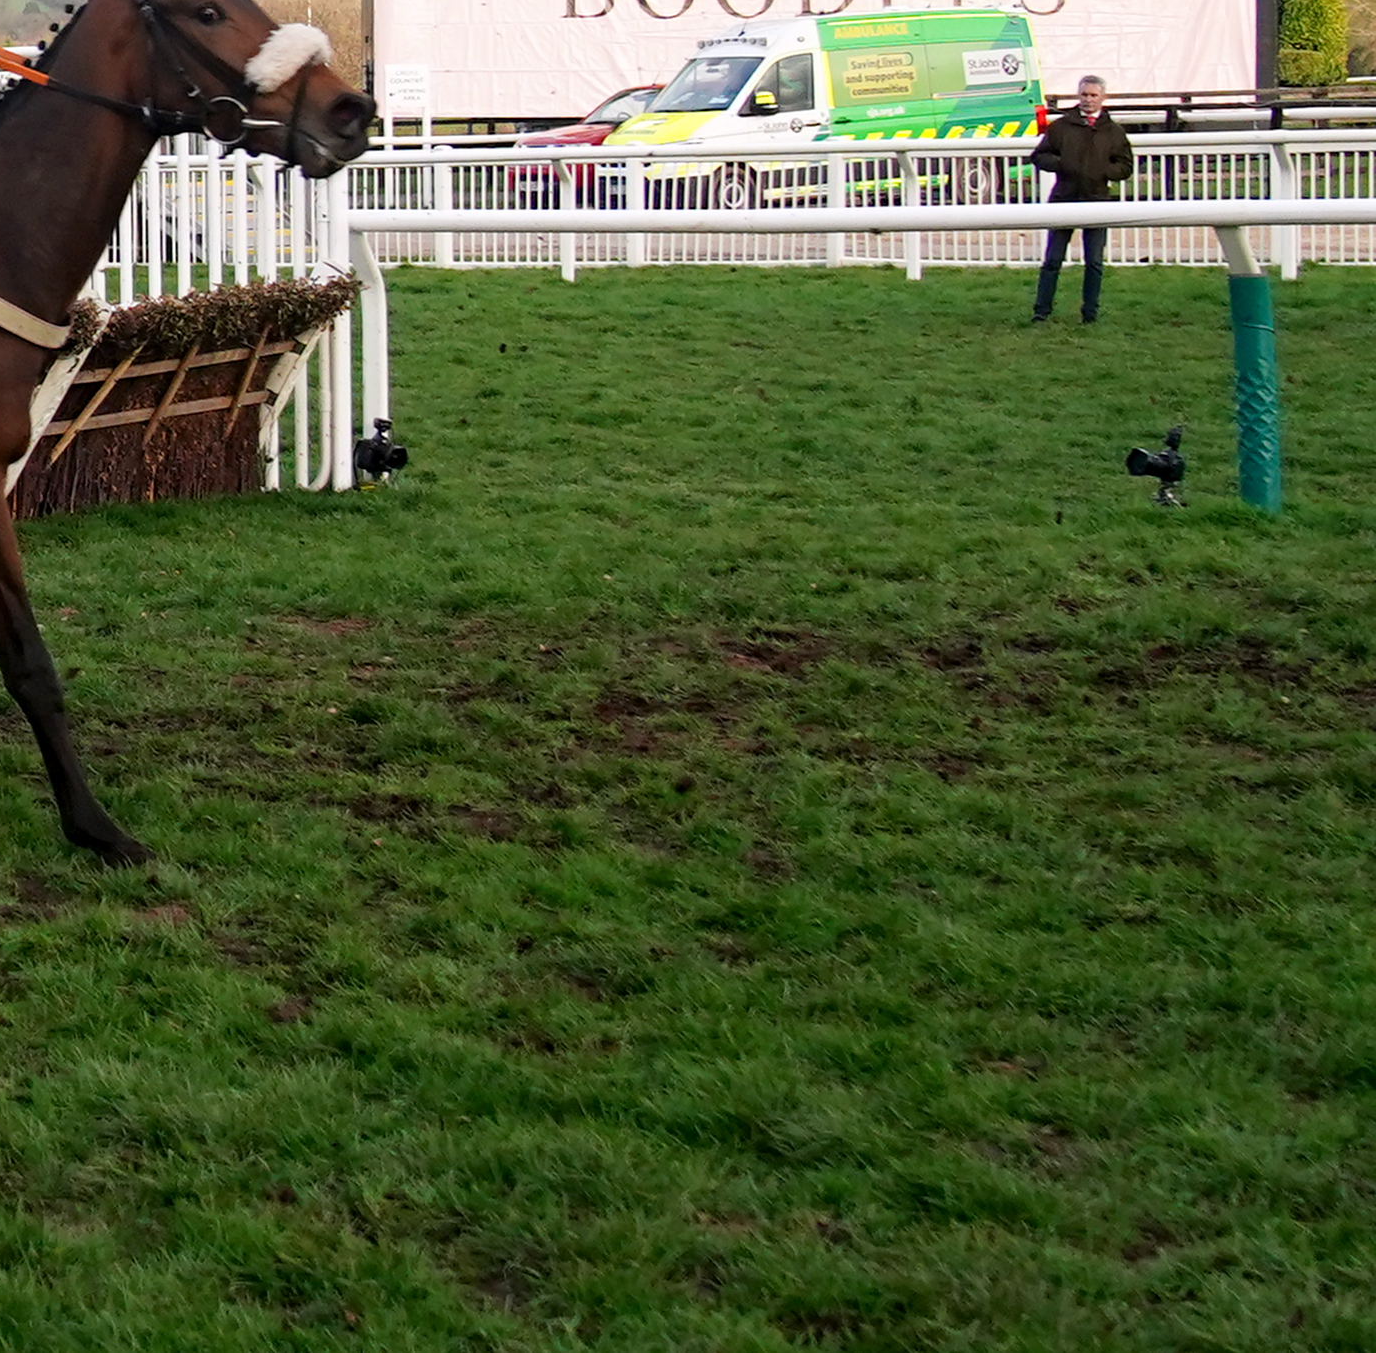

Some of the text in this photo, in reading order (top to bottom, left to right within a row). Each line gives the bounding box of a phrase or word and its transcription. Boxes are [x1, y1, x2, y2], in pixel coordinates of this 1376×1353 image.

[834, 23, 909, 39] AMBULANCE
[851, 56, 903, 70] Saving lives
[845, 69, 914, 84] and supporting
[852, 84, 909, 96] communities
